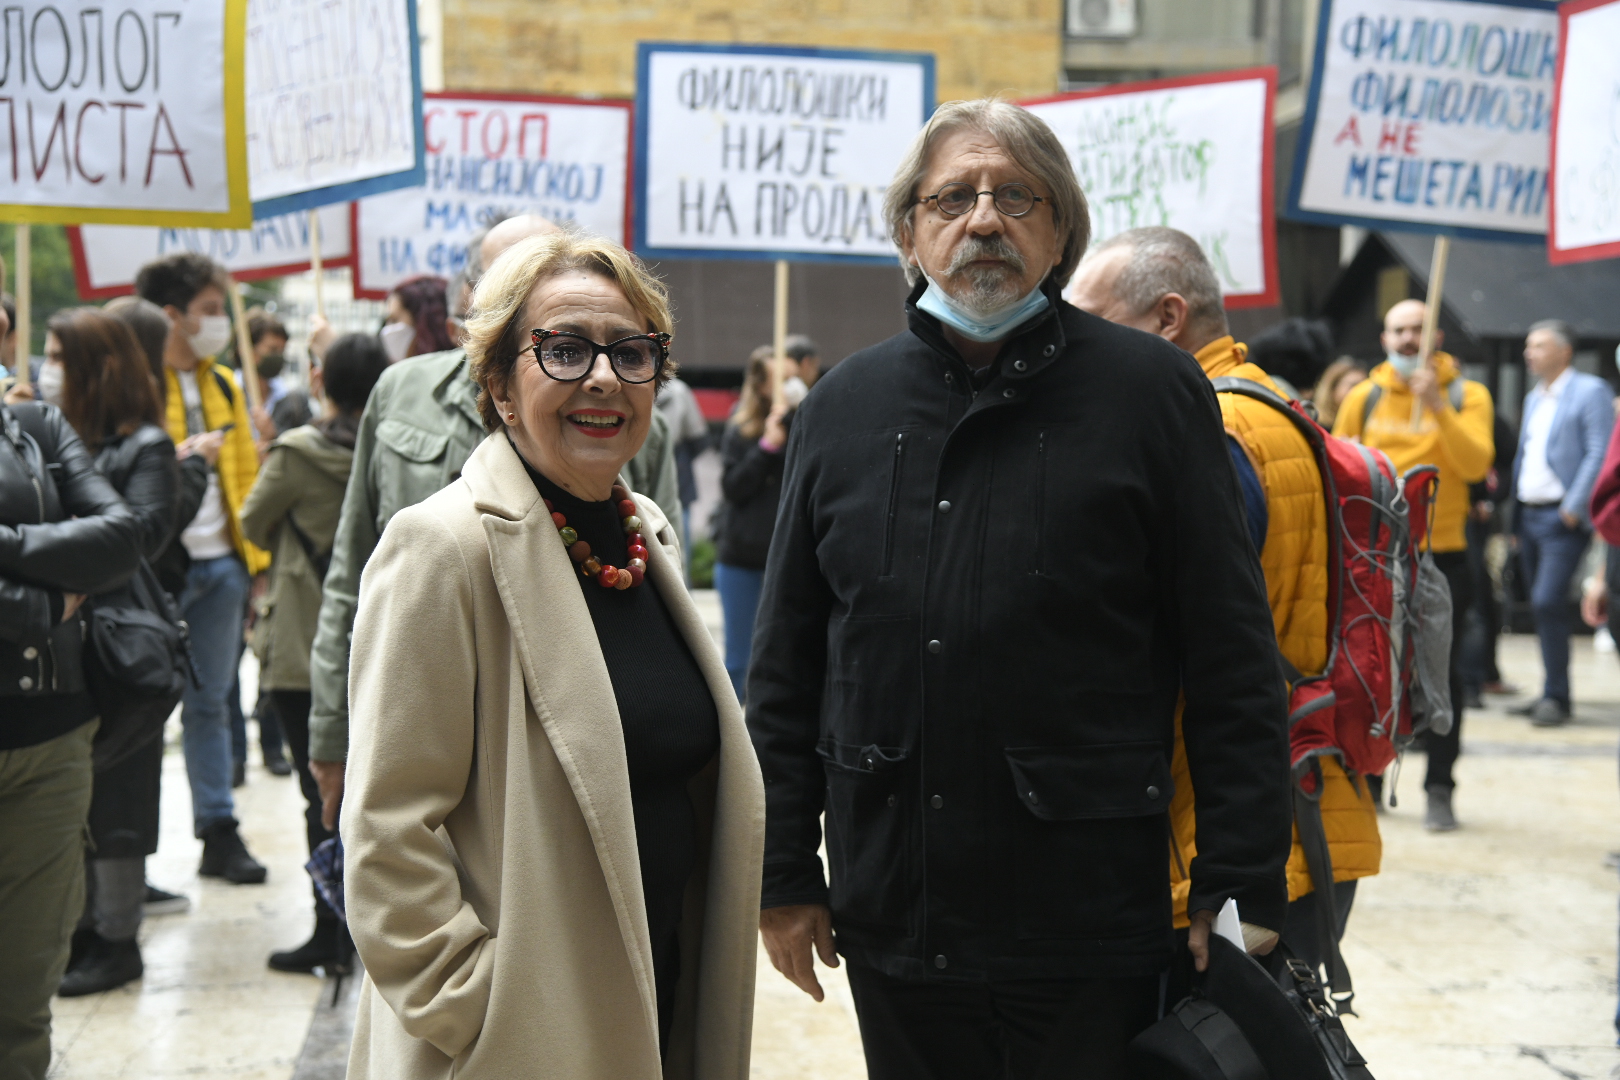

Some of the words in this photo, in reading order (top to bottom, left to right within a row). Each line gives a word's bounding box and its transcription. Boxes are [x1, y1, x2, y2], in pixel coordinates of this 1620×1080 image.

[677, 66, 888, 121] ФИЛОЛОШКИ
[424, 107, 549, 160] СТОП
[721, 122, 844, 178] НИЈЕ
[1334, 117, 1362, 147] А
[1378, 120, 1422, 154] НЕ
[679, 180, 738, 236] НА
[755, 182, 888, 243] ПРОДА
